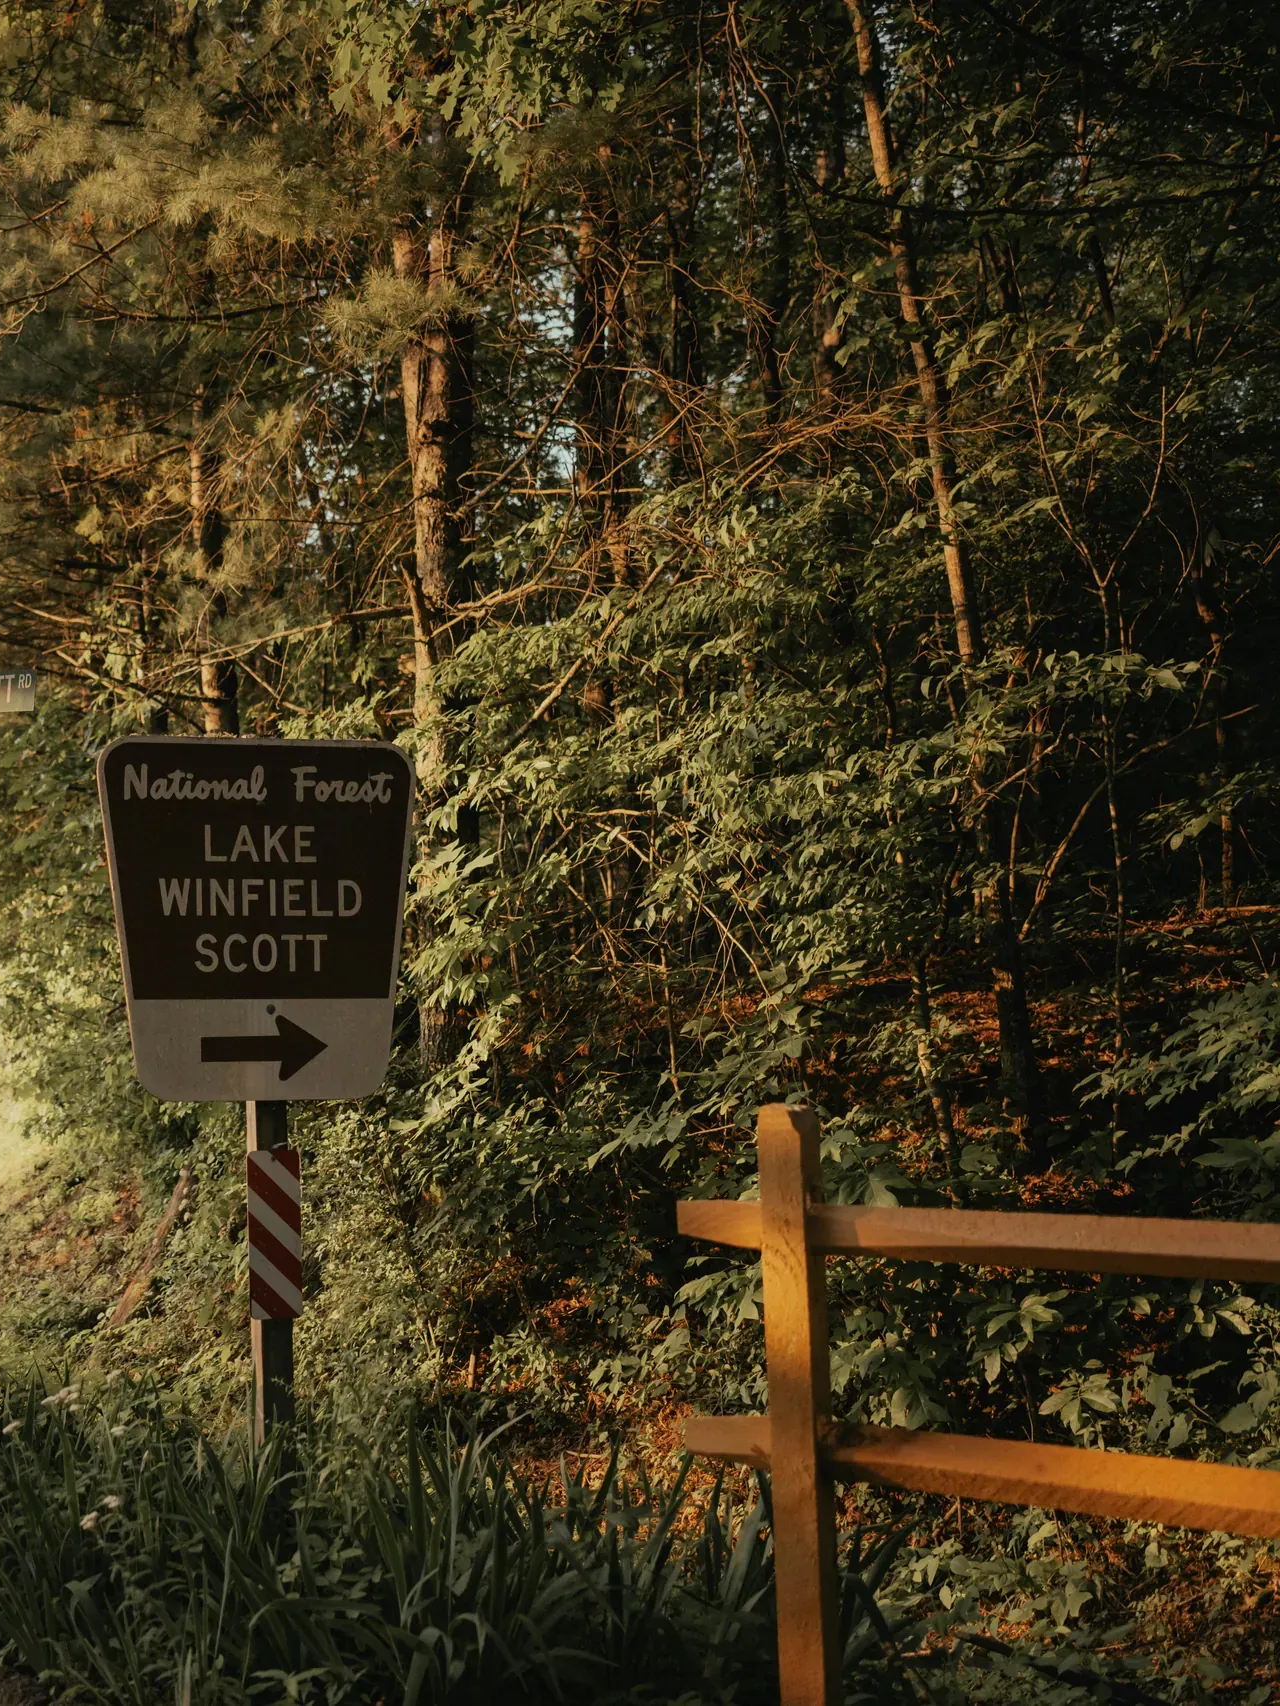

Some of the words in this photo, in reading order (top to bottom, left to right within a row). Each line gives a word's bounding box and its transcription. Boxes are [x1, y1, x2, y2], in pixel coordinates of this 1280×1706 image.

[18, 673, 32, 689] RD
[123, 763, 268, 802] National
[290, 765, 394, 804] Forest
[204, 824, 317, 863] LAKE
[158, 877, 362, 917] WINFIELD
[194, 933, 328, 973] SCOTT
